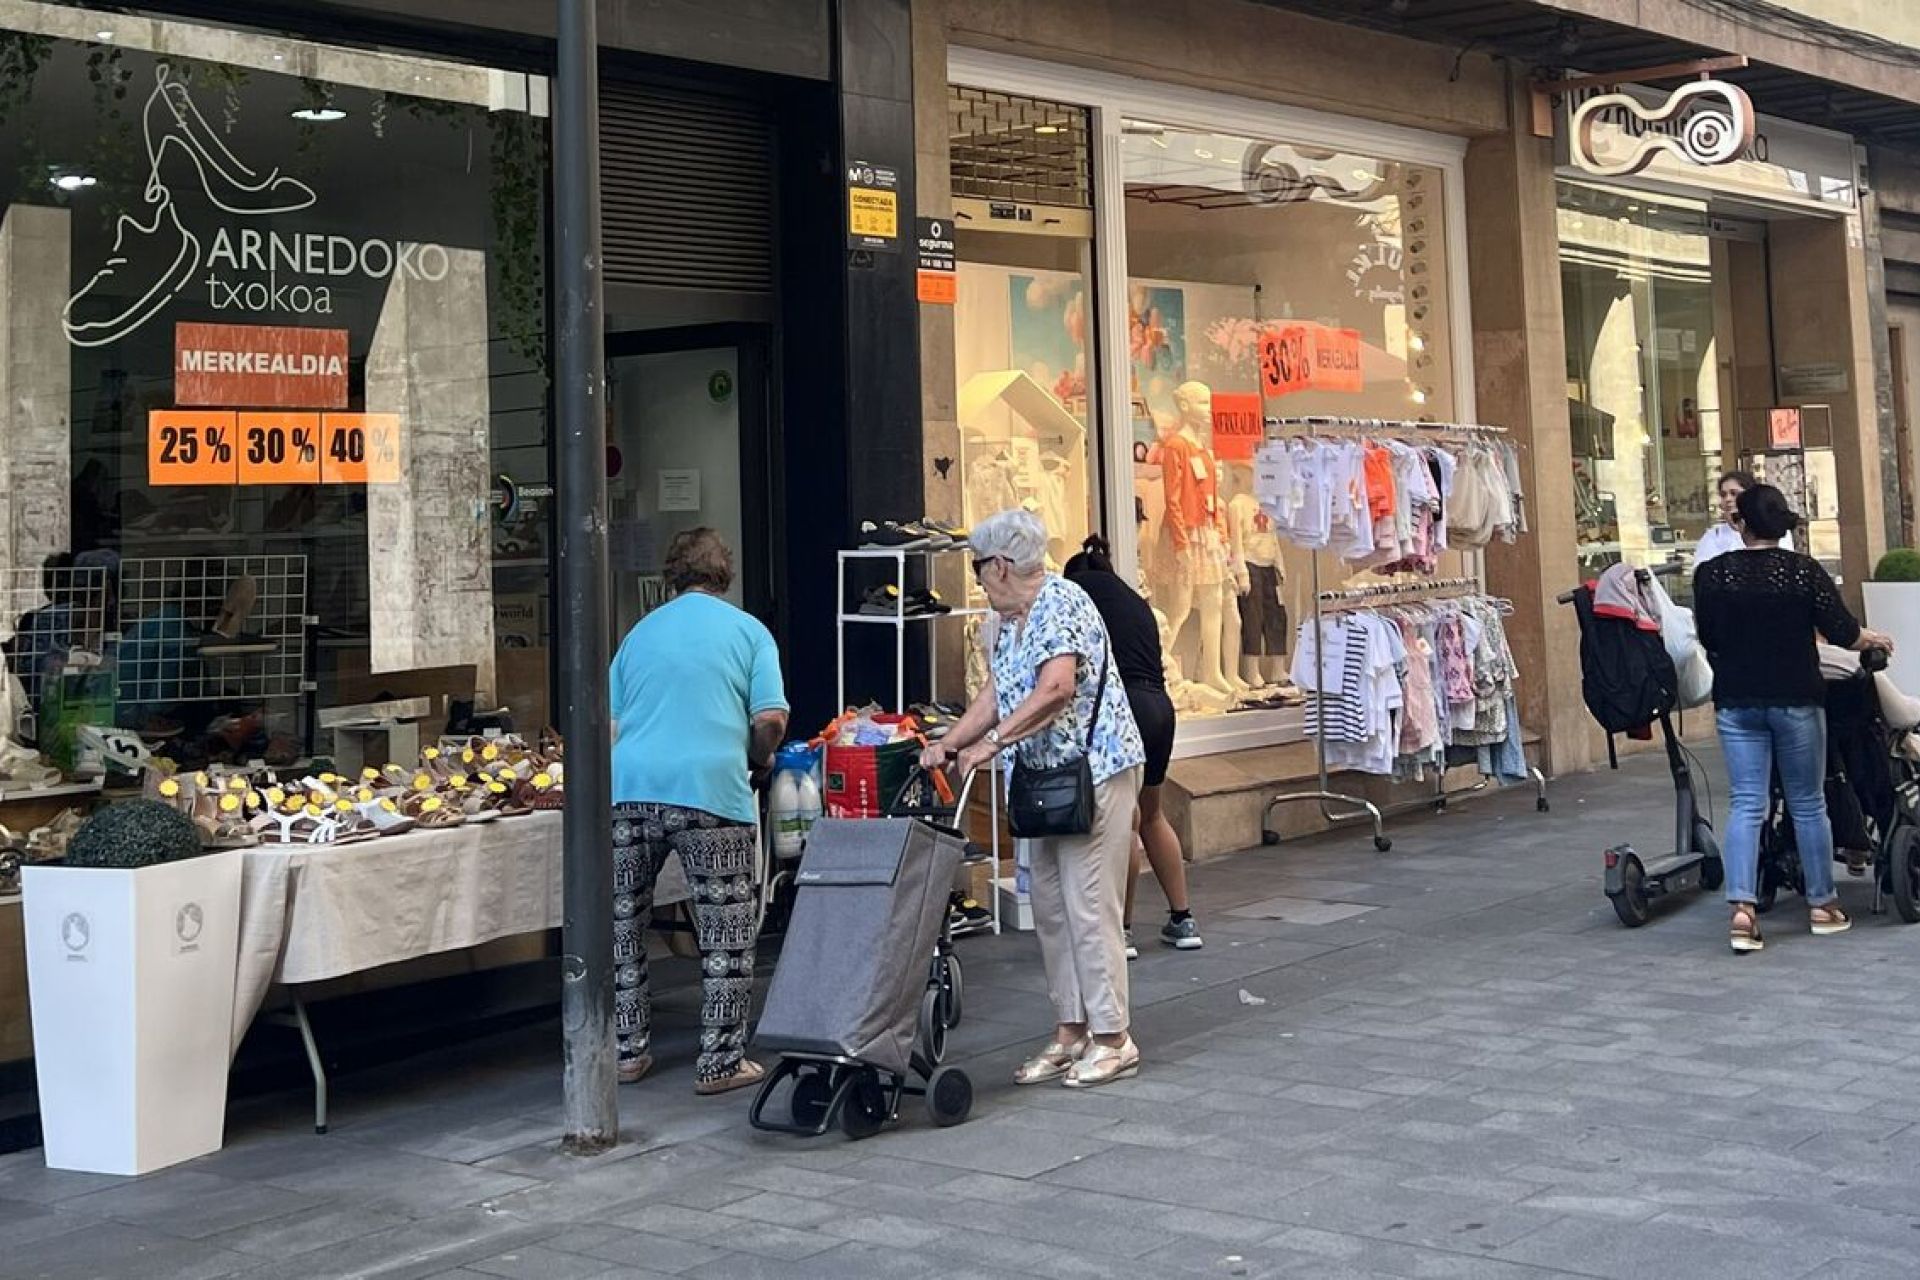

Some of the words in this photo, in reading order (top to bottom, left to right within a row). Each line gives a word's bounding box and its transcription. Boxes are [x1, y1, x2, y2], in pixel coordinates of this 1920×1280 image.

[206, 226, 449, 281] ARNEDOKO
[204, 272, 333, 314] txokoa
[182, 348, 344, 377] MERKEALDIA
[1262, 335, 1311, 386] -30%
